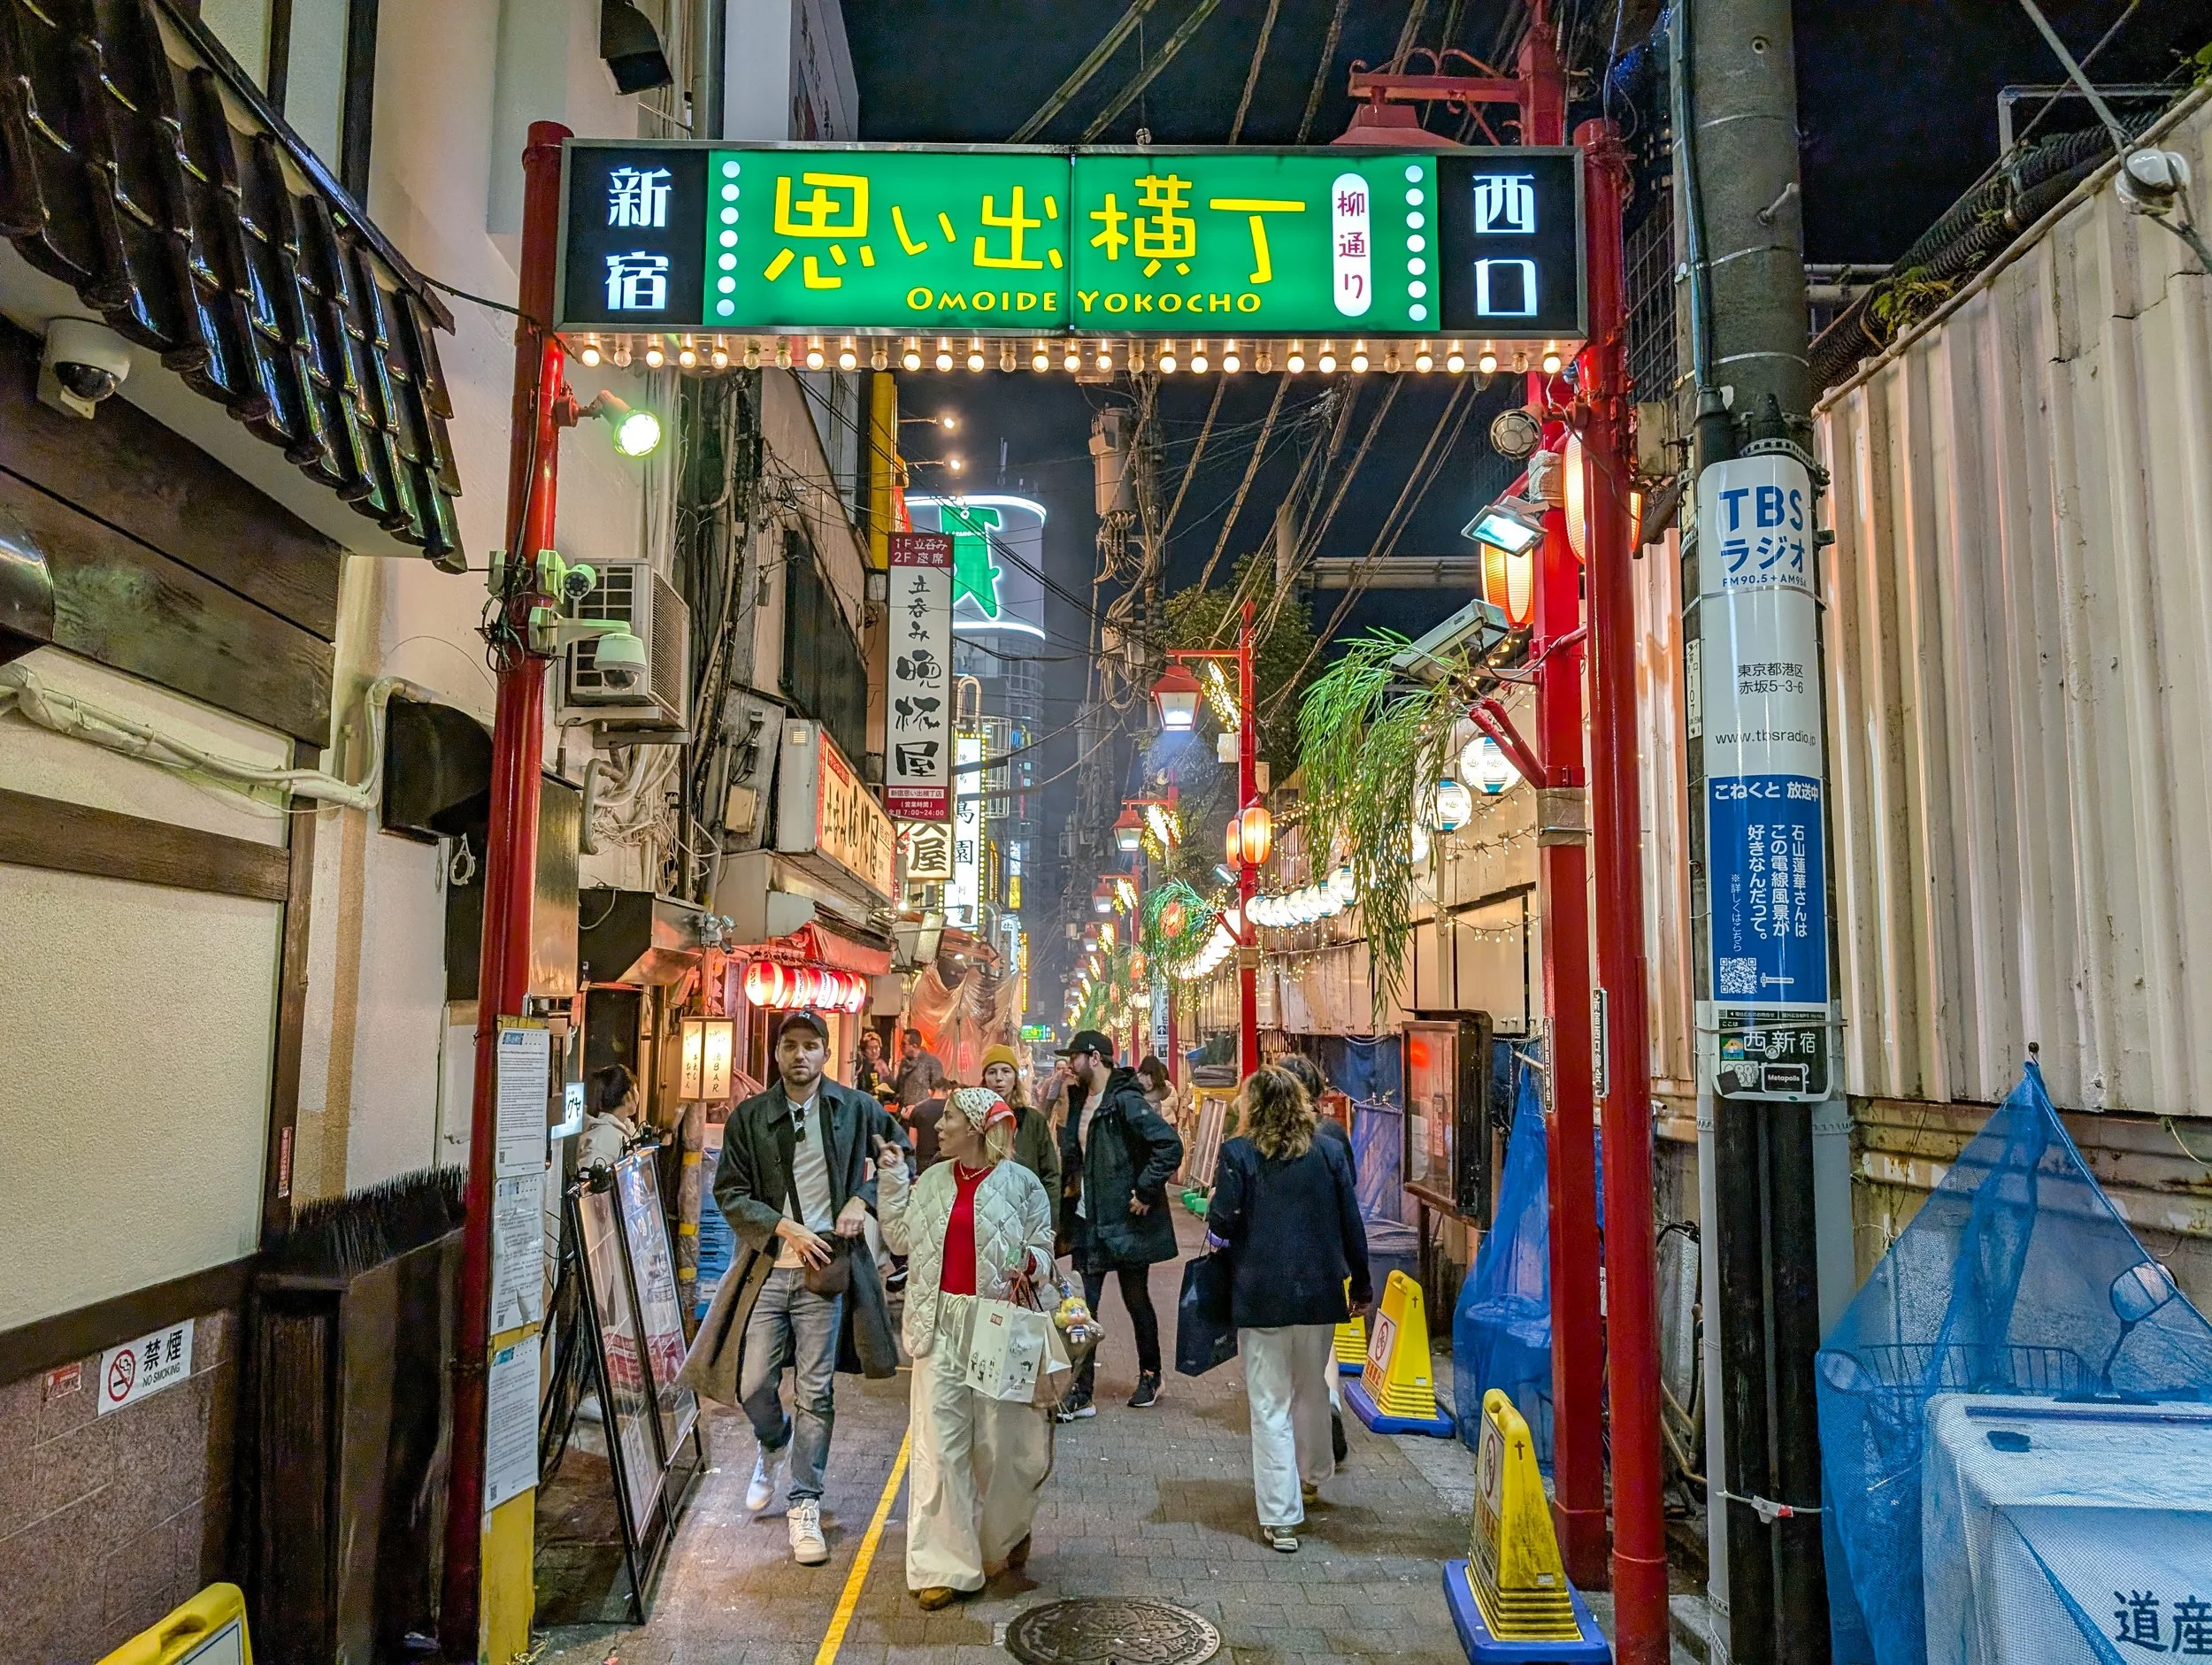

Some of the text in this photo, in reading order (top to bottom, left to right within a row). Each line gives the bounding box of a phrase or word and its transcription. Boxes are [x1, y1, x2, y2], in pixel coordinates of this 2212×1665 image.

[603, 166, 672, 311] 新宿
[763, 172, 1306, 289] 思い出横丁
[1336, 189, 1367, 301] 柳通り
[1472, 173, 1538, 317] 西口
[906, 286, 1262, 313] OMOIDE YOKOCHO
[1718, 485, 1804, 533] TBS
[894, 538, 949, 552] 1F 立呑み
[894, 551, 911, 564] 2F
[1719, 534, 1806, 574] ラジオ
[1722, 574, 1768, 588] FM90.5
[908, 574, 932, 642] 立呑み
[1737, 662, 1803, 679] 東京都港区
[1739, 679, 1804, 694] 赤坂5-3-6
[1716, 729, 1816, 746] www.tbsradio.jp
[890, 789, 942, 798] 新宿思い出横丁店
[1714, 780, 1819, 802] こねくと 放送中
[1747, 824, 1768, 940] 好きなんだって。
[1770, 824, 1791, 938] この電線風景が
[1791, 824, 1808, 939] 石山蓮華さんは
[1742, 1030, 1816, 1054] 西新宿
[1767, 1074, 1801, 1083] Metapolis
[143, 1329, 184, 1372] 禁煙
[142, 1362, 181, 1388] NO SMOKING
